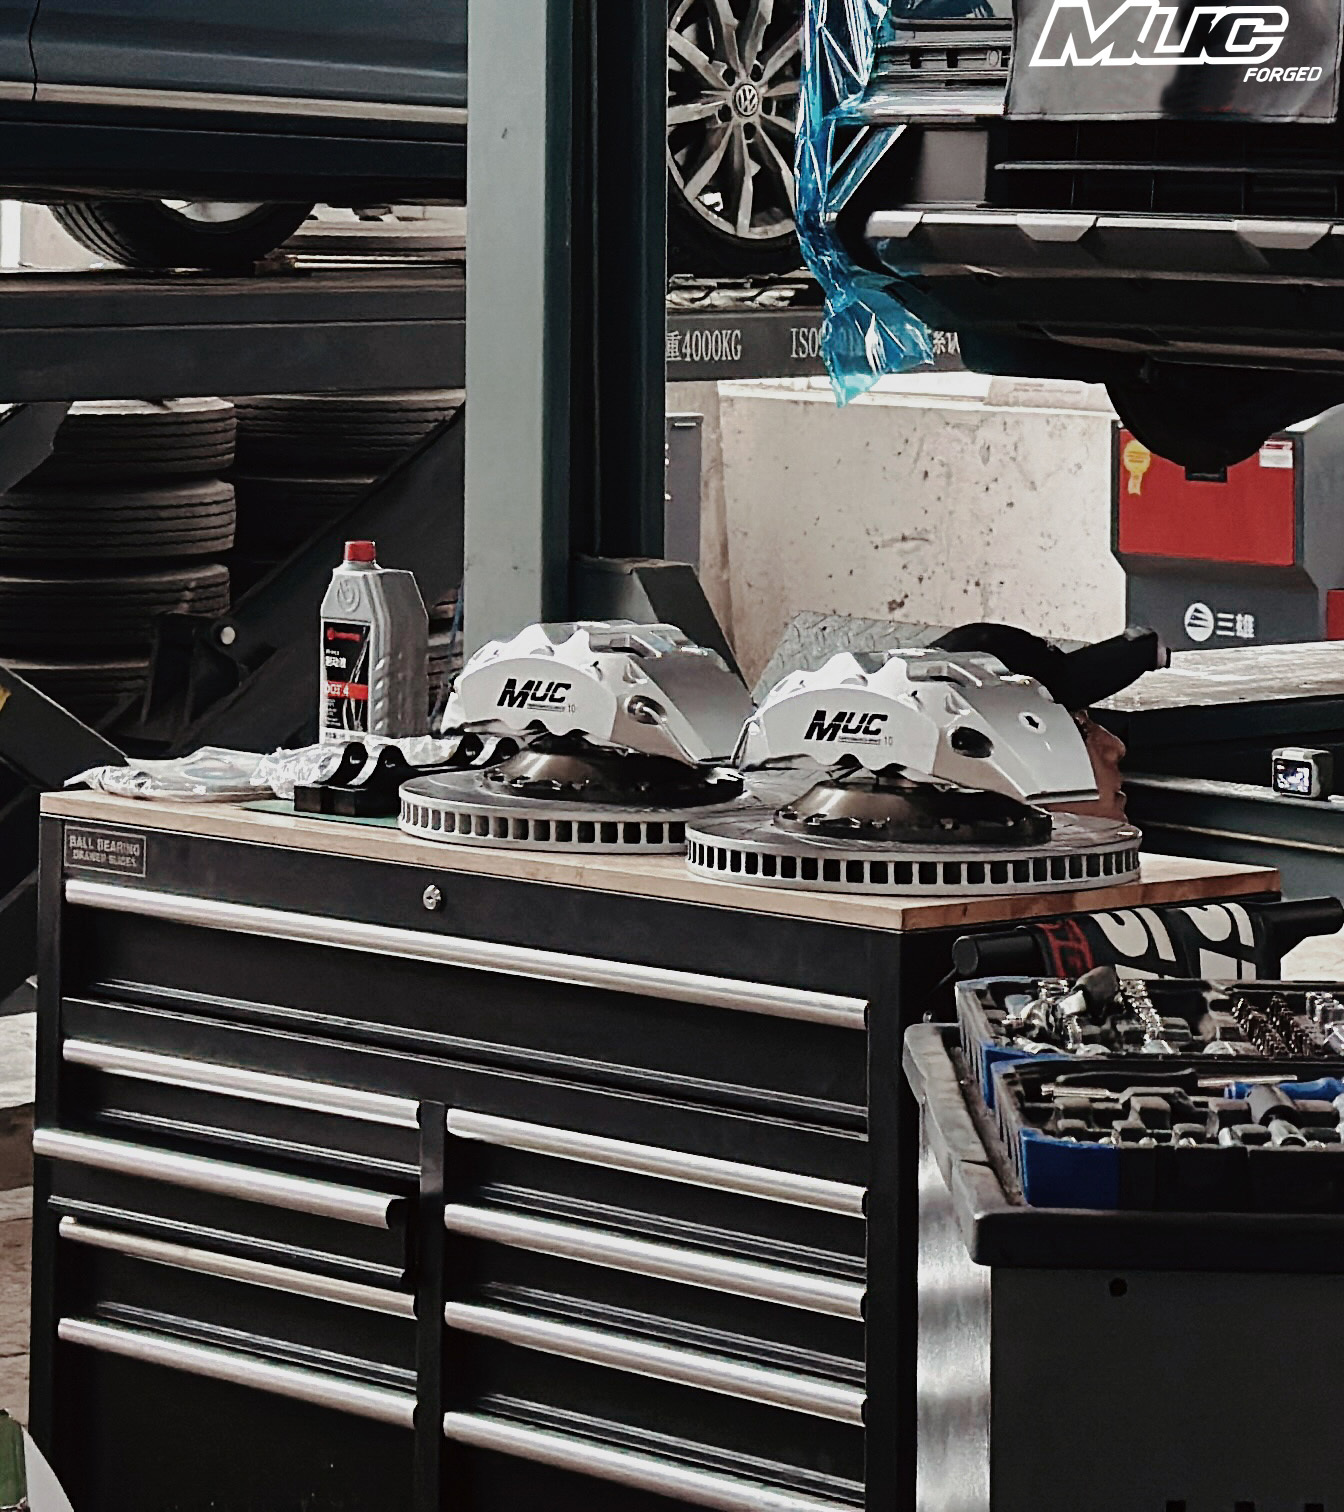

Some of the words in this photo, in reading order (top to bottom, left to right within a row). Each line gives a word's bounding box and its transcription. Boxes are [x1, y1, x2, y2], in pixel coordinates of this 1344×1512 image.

[1243, 66, 1323, 83] FORGED
[497, 677, 572, 709] MUC
[803, 709, 889, 742] MUC
[69, 835, 94, 849] BALL
